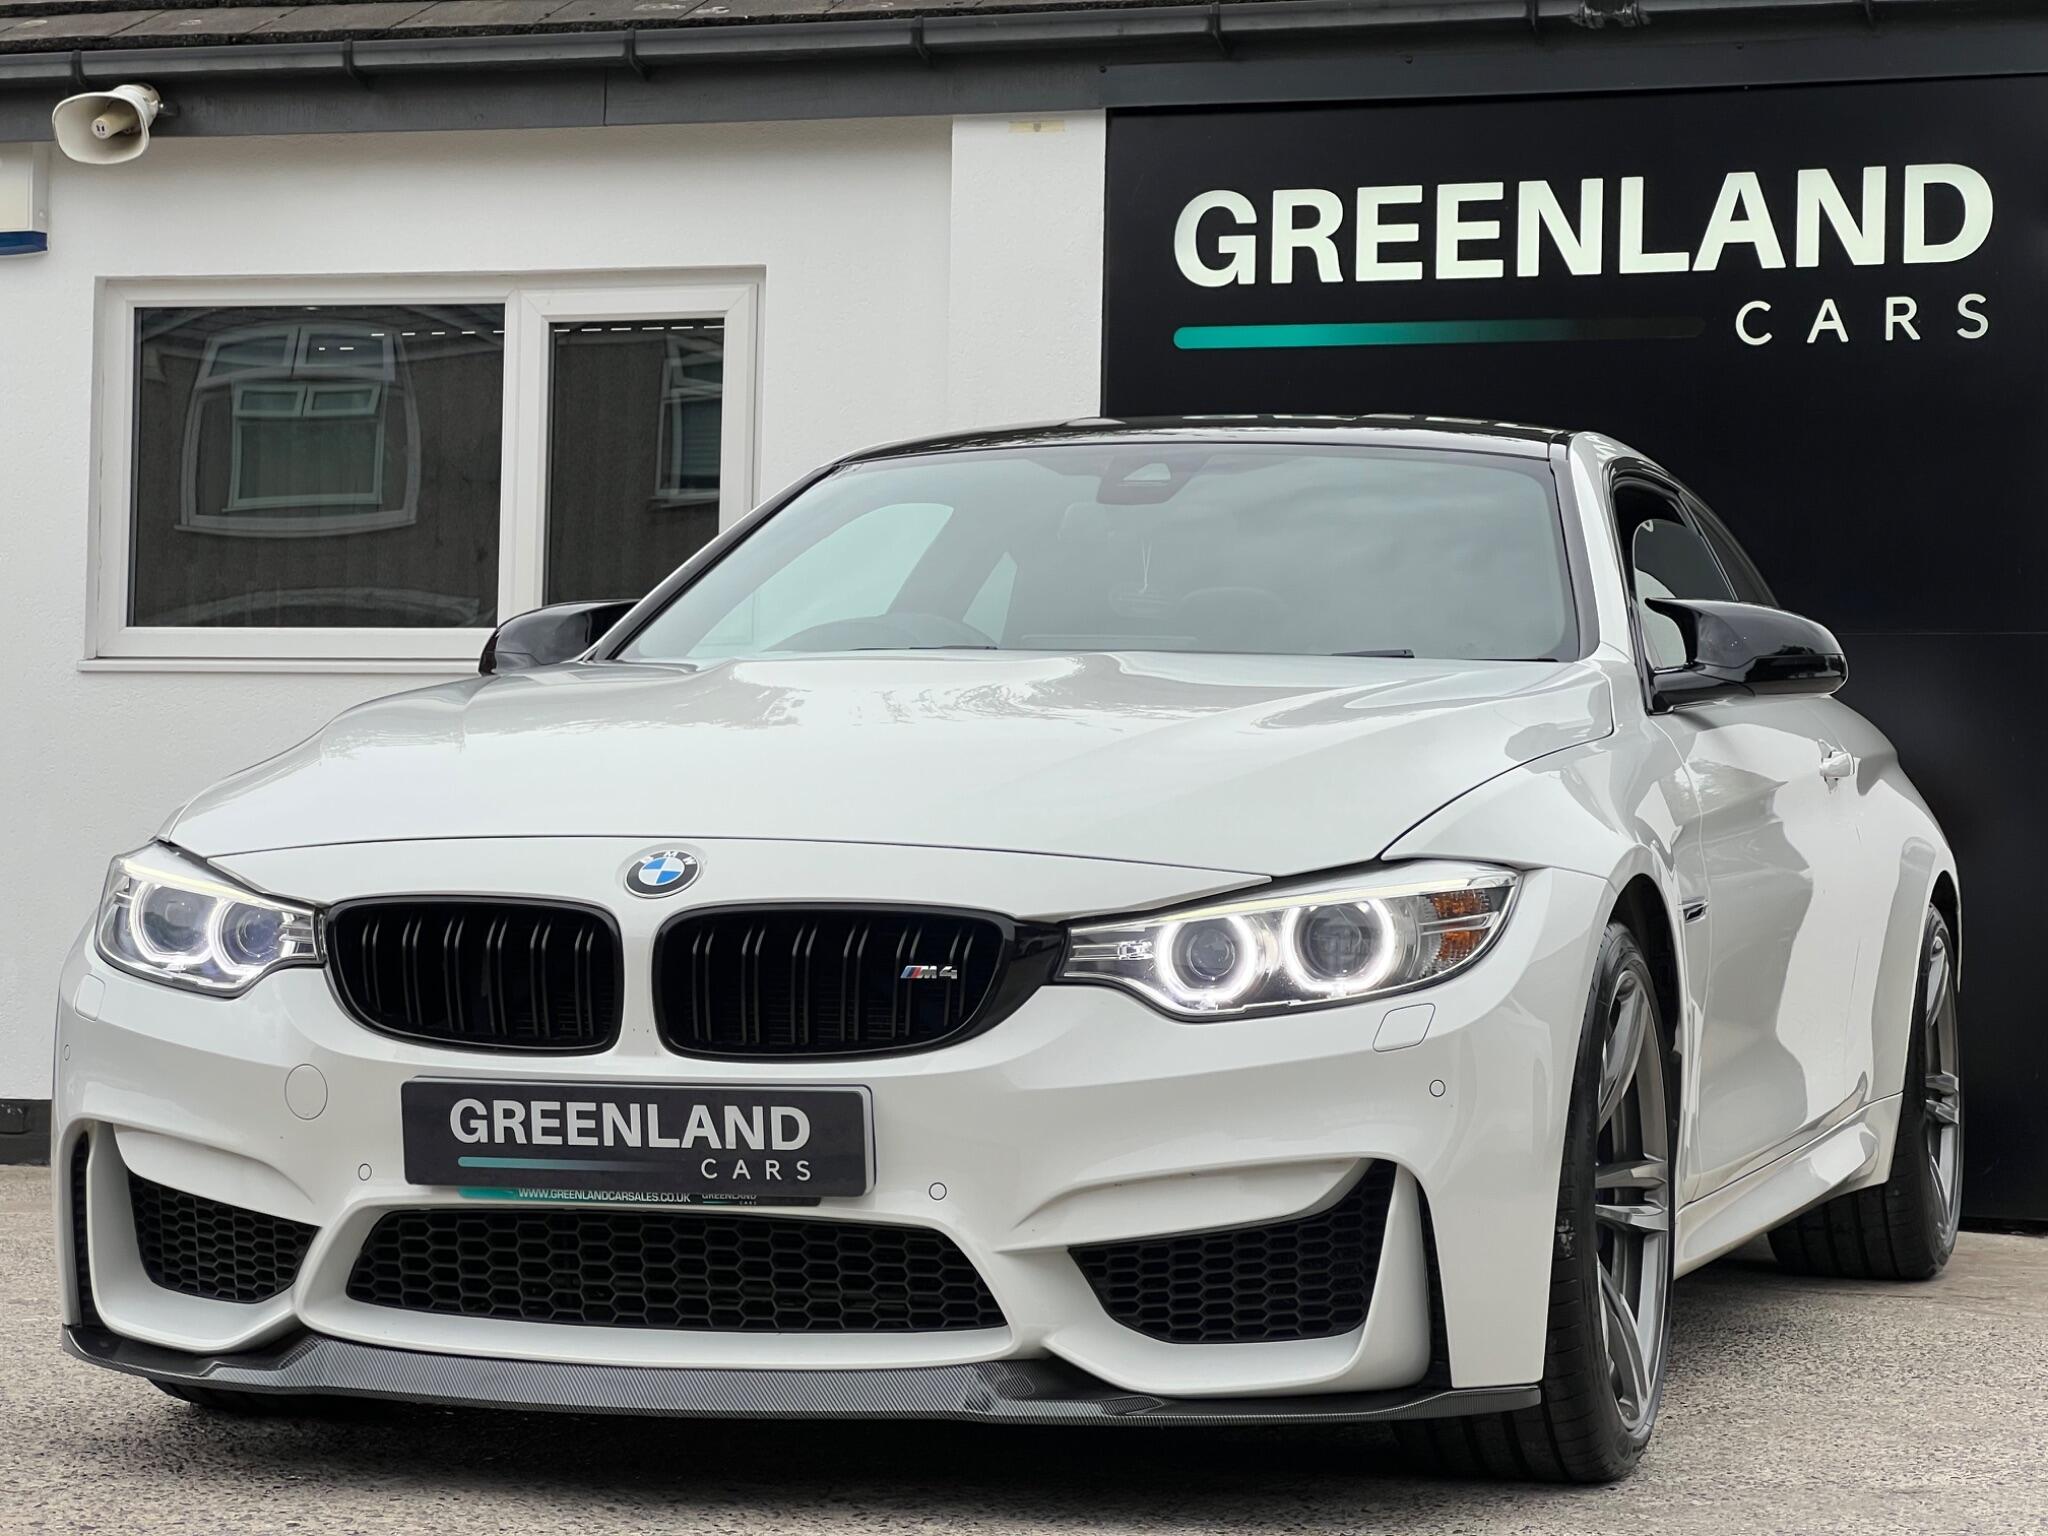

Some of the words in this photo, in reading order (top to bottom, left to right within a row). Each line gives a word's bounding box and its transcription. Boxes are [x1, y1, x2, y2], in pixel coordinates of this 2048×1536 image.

[1174, 163, 1994, 288] GREENLAND
[1736, 293, 1990, 346] CARS
[904, 965, 958, 980] M4
[449, 1099, 811, 1150] GREENLAND
[701, 1159, 811, 1181] CARS
[518, 1187, 691, 1203] WWW.GREENLANDCARSALES.CO.UK
